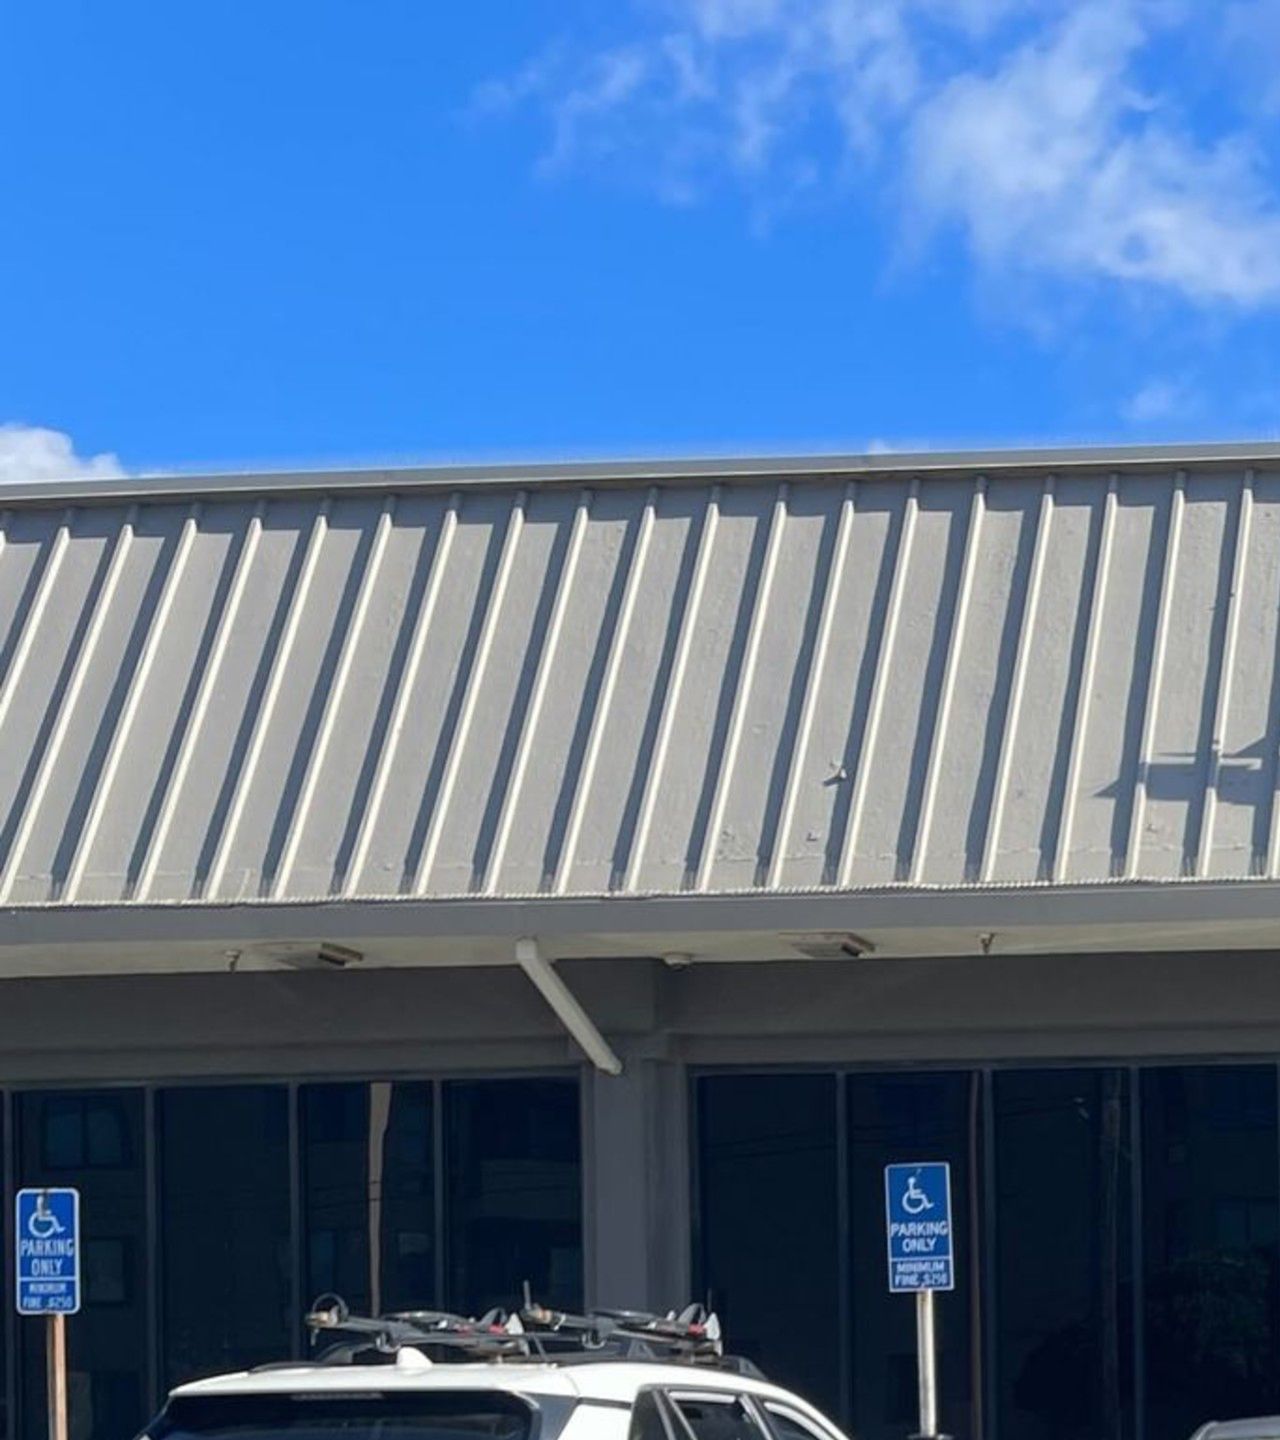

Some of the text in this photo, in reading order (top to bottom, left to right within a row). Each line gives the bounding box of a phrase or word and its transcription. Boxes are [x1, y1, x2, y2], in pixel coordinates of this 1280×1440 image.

[890, 1220, 949, 1237] PARKING
[20, 1239, 74, 1257] PARKING
[902, 1237, 937, 1253] ONLY
[31, 1258, 62, 1276] ONLY
